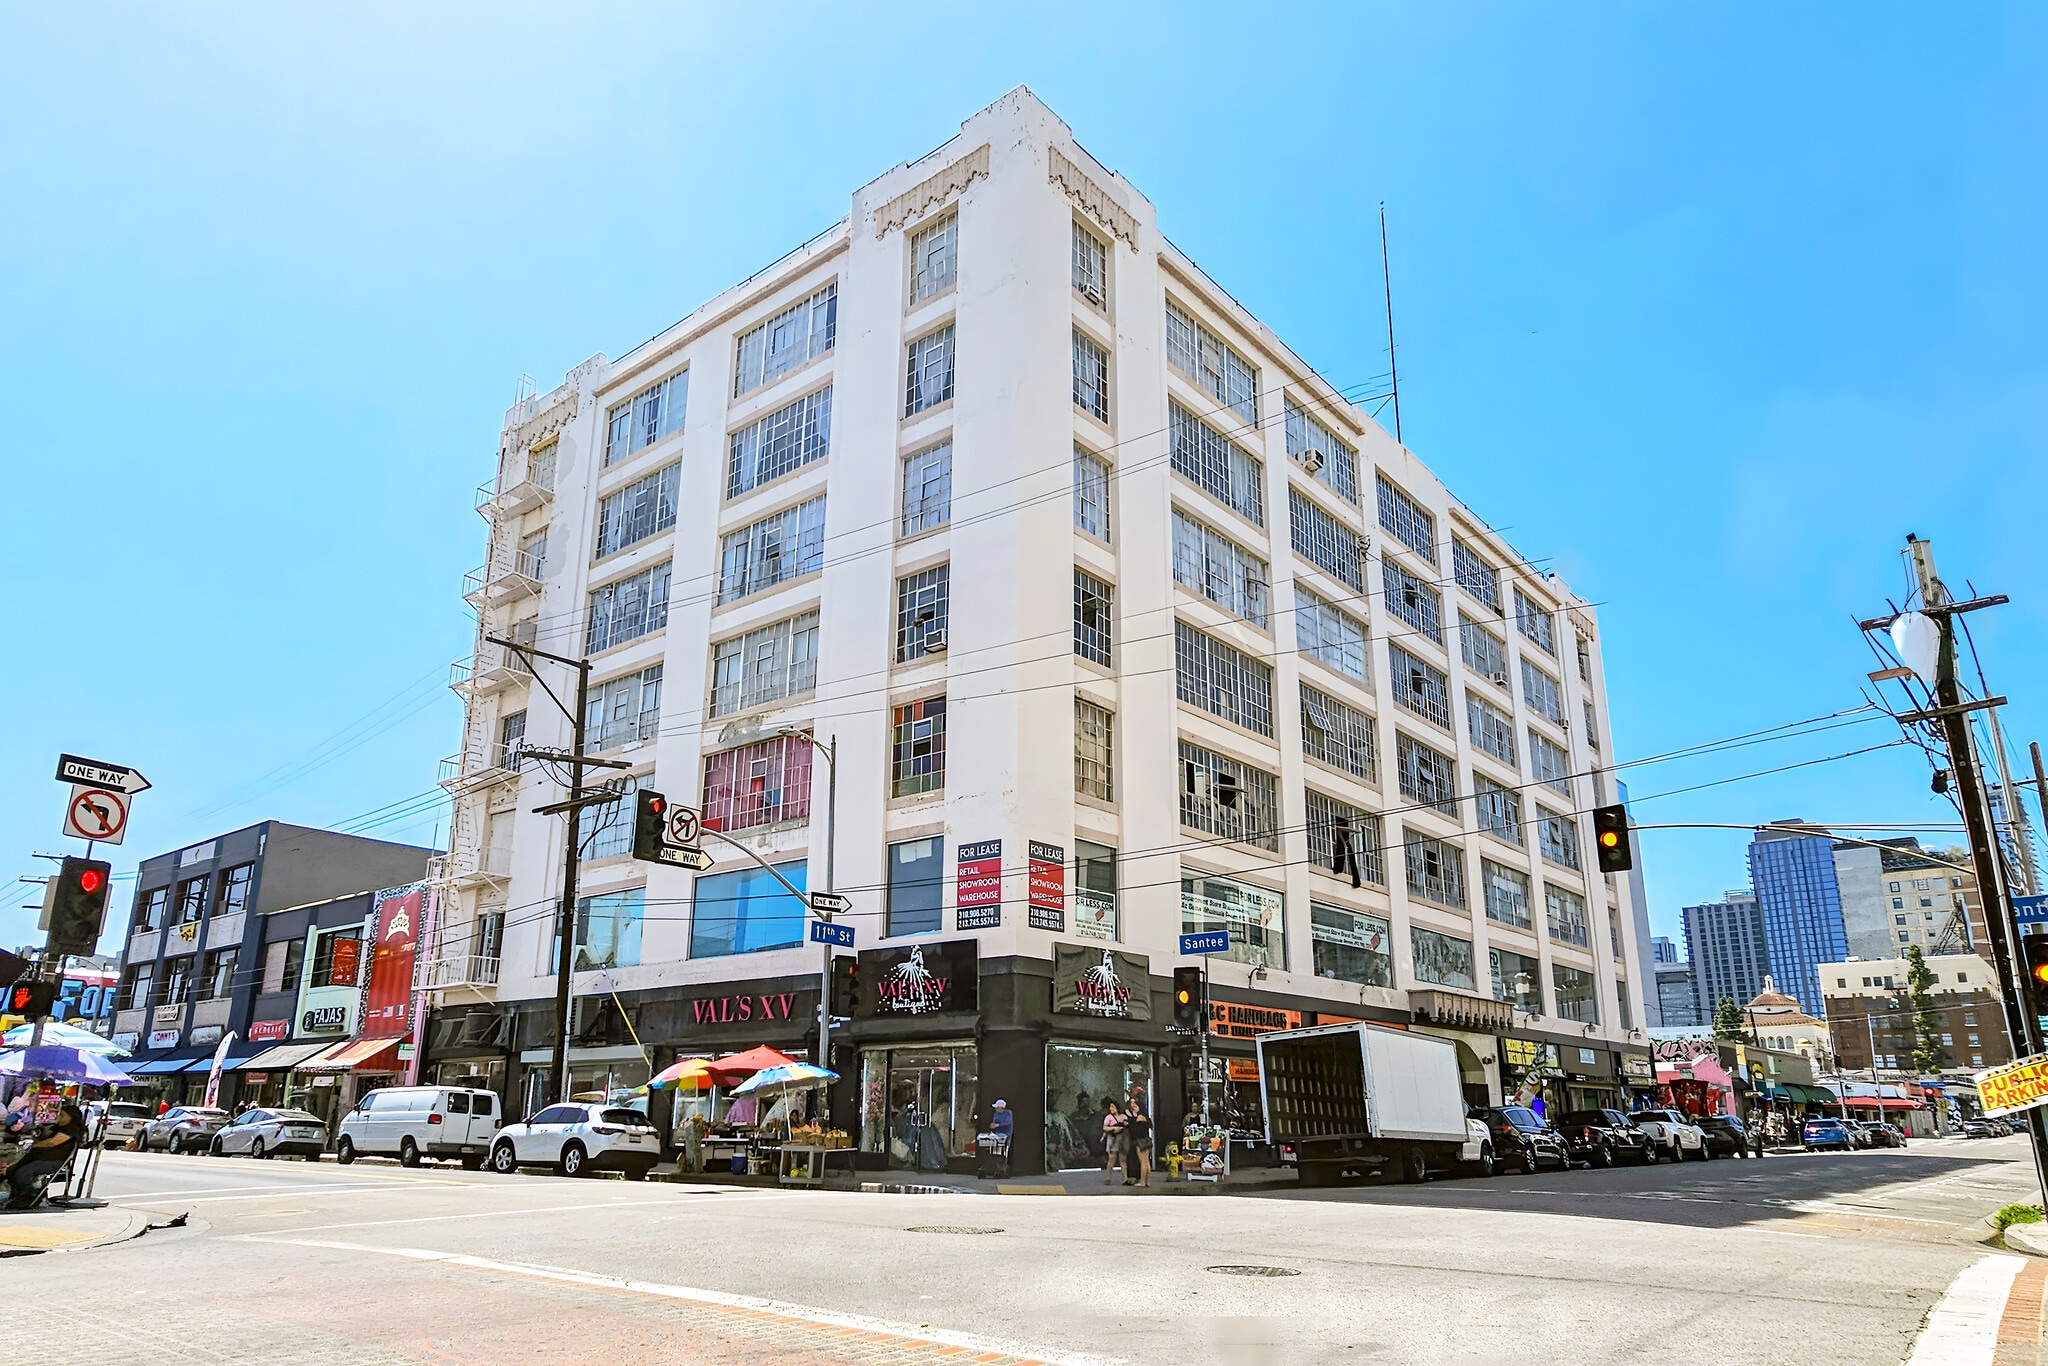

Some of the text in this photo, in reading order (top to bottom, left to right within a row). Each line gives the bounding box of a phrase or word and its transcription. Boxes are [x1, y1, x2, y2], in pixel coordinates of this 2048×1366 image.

[67, 764, 125, 785] ONE WAY
[659, 848, 700, 865] ONE WAY
[959, 843, 999, 859] FOR LEASE
[1030, 844, 1063, 861] FOR LEASE
[959, 866, 980, 876] RETAIL
[958, 877, 999, 890] SHOWROOM
[1030, 878, 1063, 891] SHOWROOM
[814, 897, 841, 908] ONE WAY
[958, 890, 999, 902] WAREHOUSE
[1030, 891, 1063, 904] WAREHOUSE
[815, 925, 851, 942] 11th St
[1354, 920, 1364, 931] FOR
[1184, 937, 1224, 950] Santee
[923, 977, 947, 994] XV
[313, 1007, 343, 1024] FAJAS
[693, 993, 795, 1024] VAL'S XV
[1228, 1006, 1287, 1029] HANDBAGS
[1980, 1063, 2048, 1096] PUBLIC
